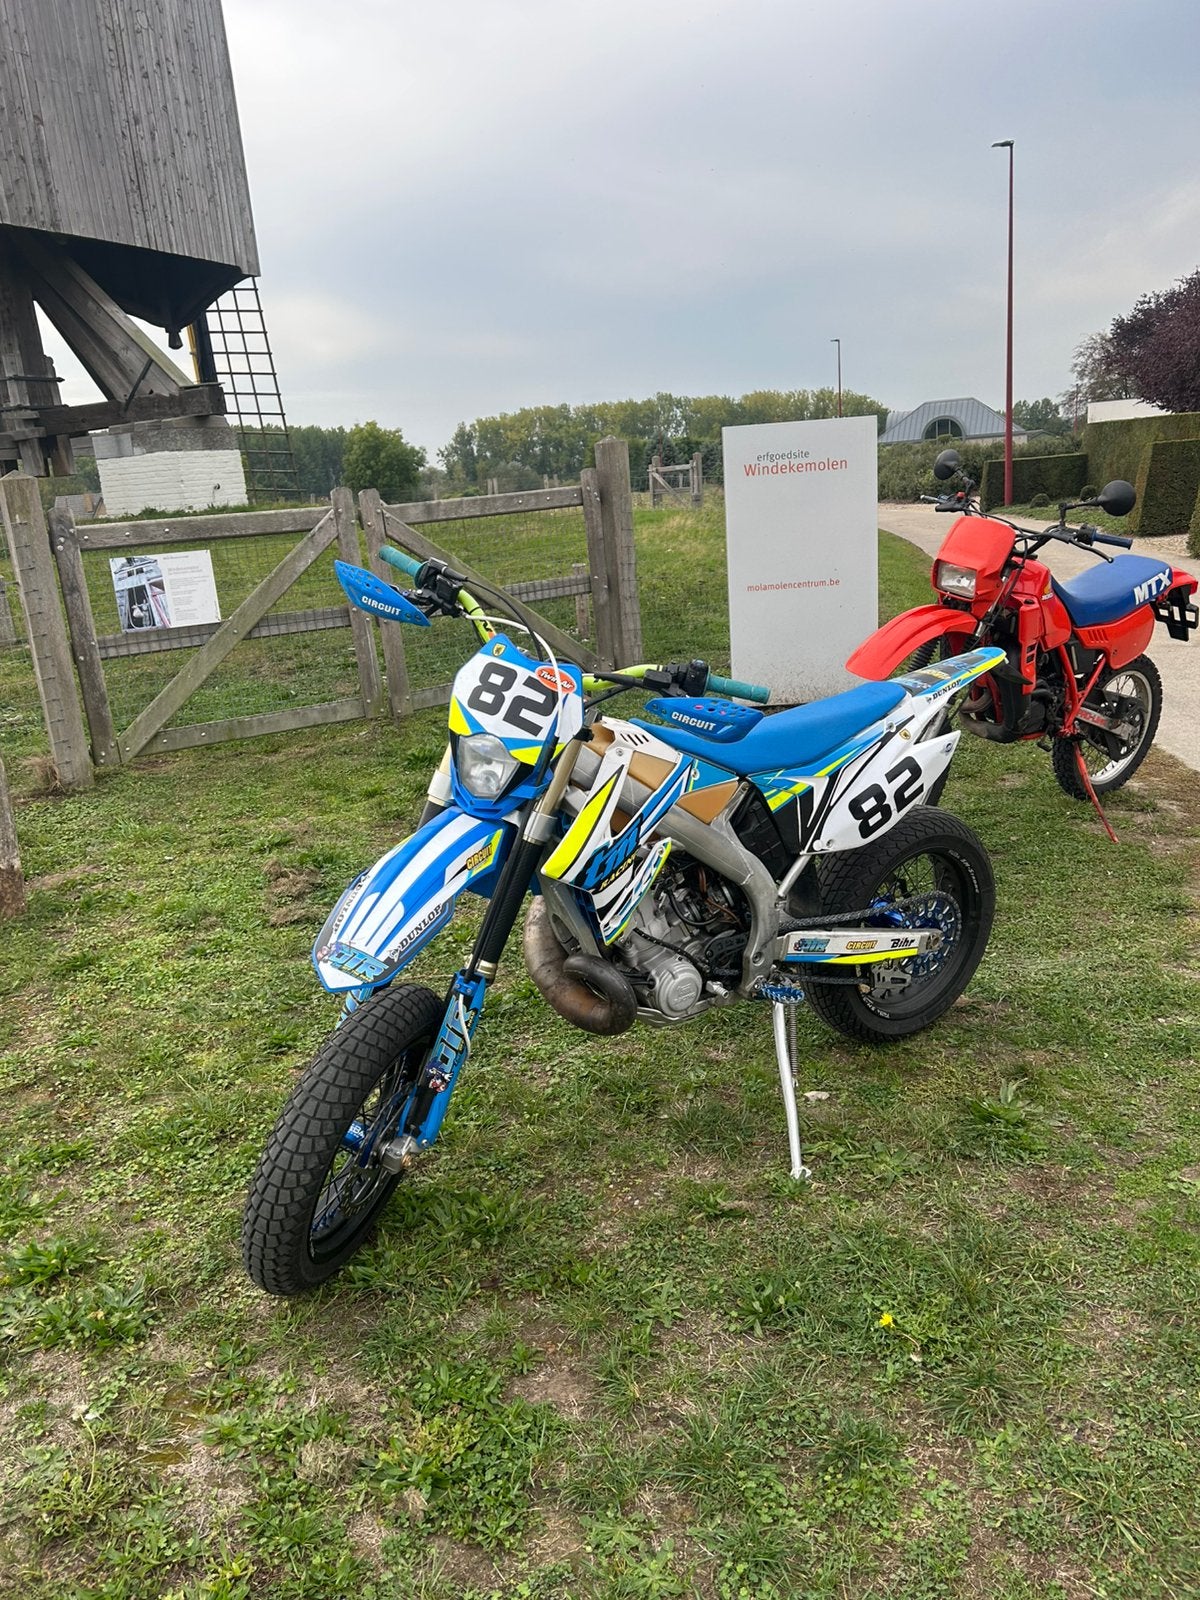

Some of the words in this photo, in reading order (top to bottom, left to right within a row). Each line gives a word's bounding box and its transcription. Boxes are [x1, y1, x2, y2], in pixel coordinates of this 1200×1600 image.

[757, 449, 810, 463] erfgoedsite
[743, 457, 848, 477] Windekemolen
[747, 578, 840, 592] molamolencentrum.be
[1133, 567, 1172, 606] MTX
[361, 595, 402, 616] CIRCUIT
[467, 661, 559, 737] 82
[932, 679, 962, 700] DUNLOP
[671, 711, 717, 731] CIRCUIT
[848, 755, 924, 839] 82
[466, 842, 493, 871] CIRCUIT
[399, 903, 442, 950] DUNLOP
[845, 940, 878, 951] CIRCUIT
[890, 937, 915, 949] Bihr
